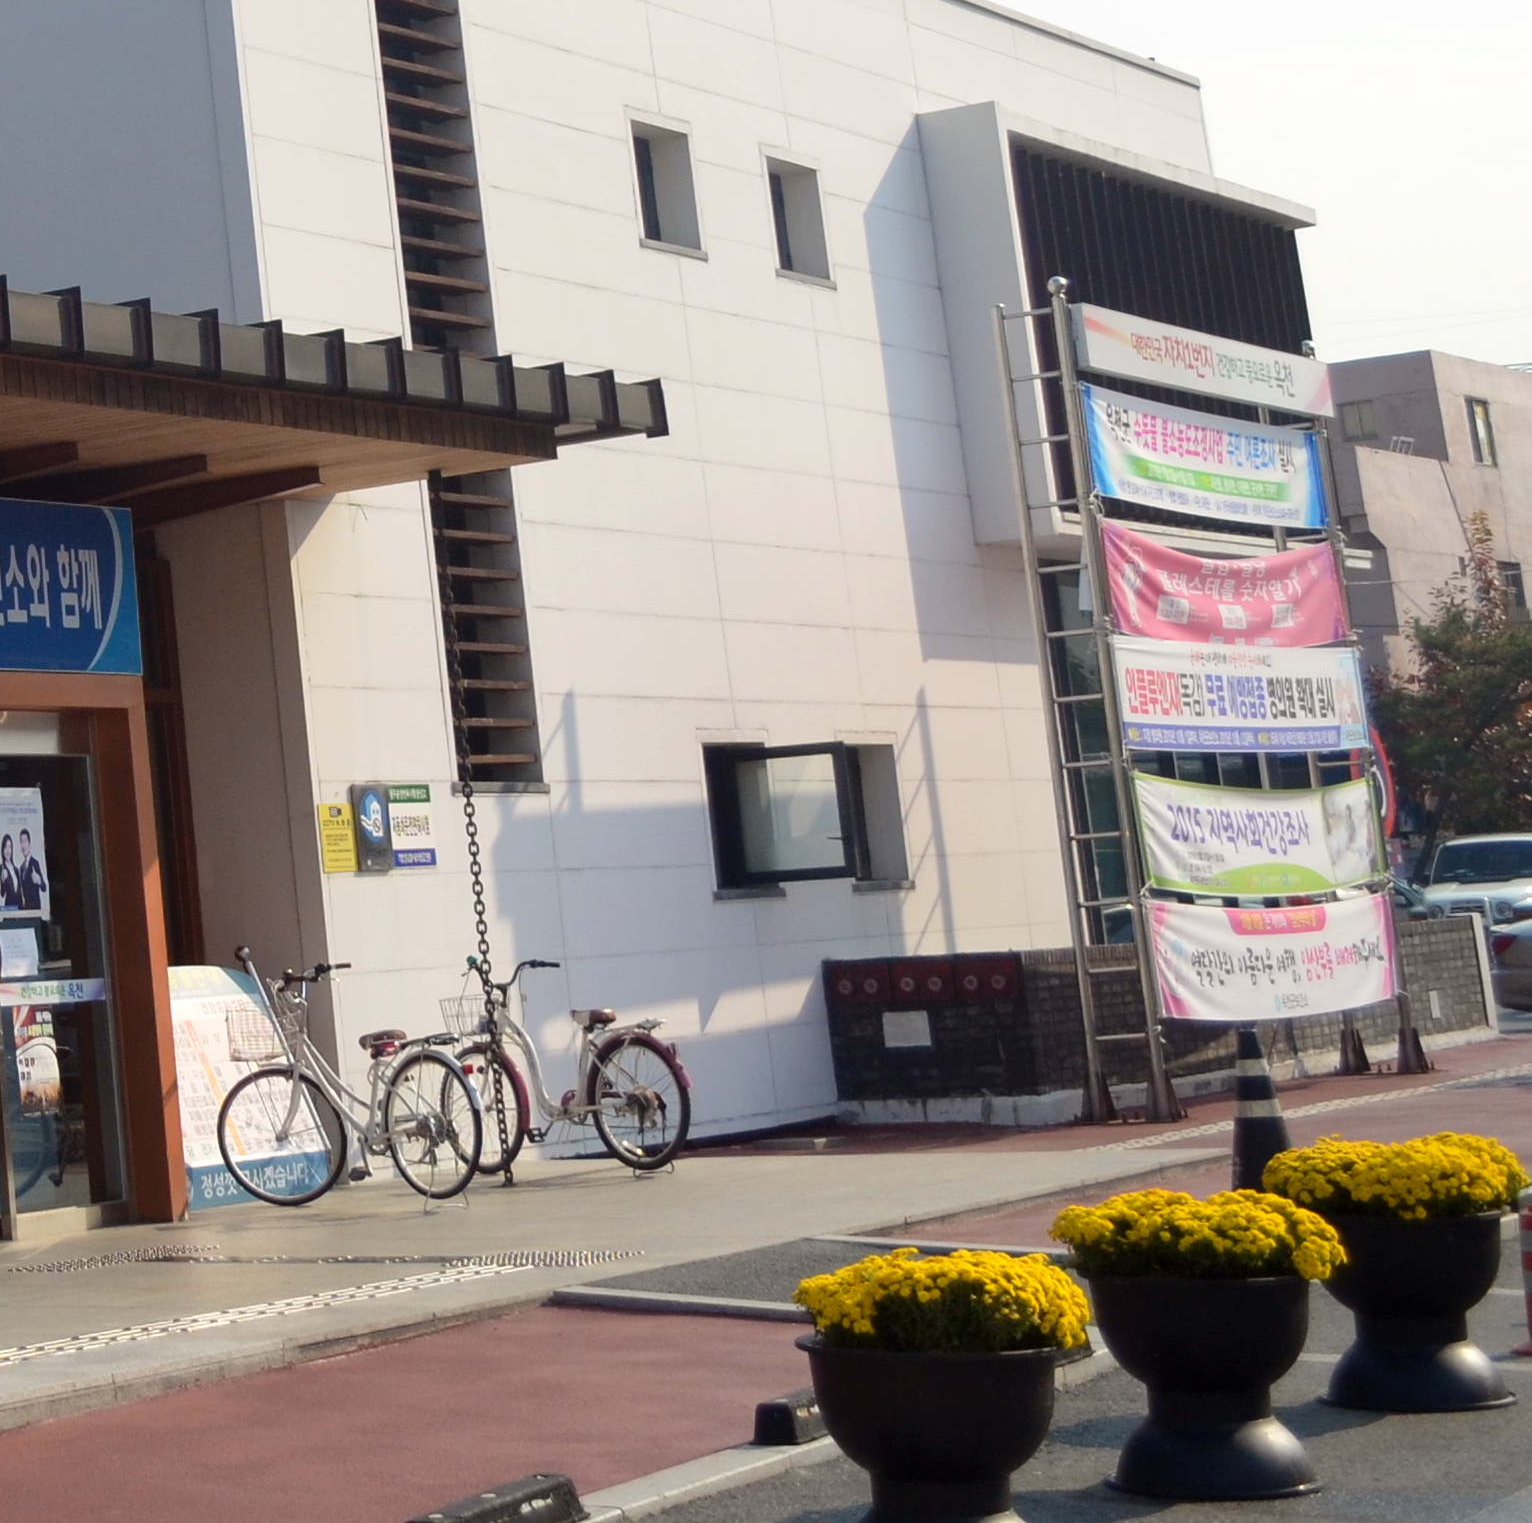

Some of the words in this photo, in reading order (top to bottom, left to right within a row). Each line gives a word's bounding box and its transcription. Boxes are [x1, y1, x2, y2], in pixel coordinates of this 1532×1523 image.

[1130, 333, 1163, 364] 대한민국
[1273, 360, 1295, 398] 옥천
[56, 543, 102, 630] 함께
[1205, 674, 1228, 717] 무료
[1317, 677, 1335, 718] 실시
[1167, 804, 1205, 844] 2015
[68, 983, 83, 998] 옥천
[201, 1171, 238, 1199] 정성껏
